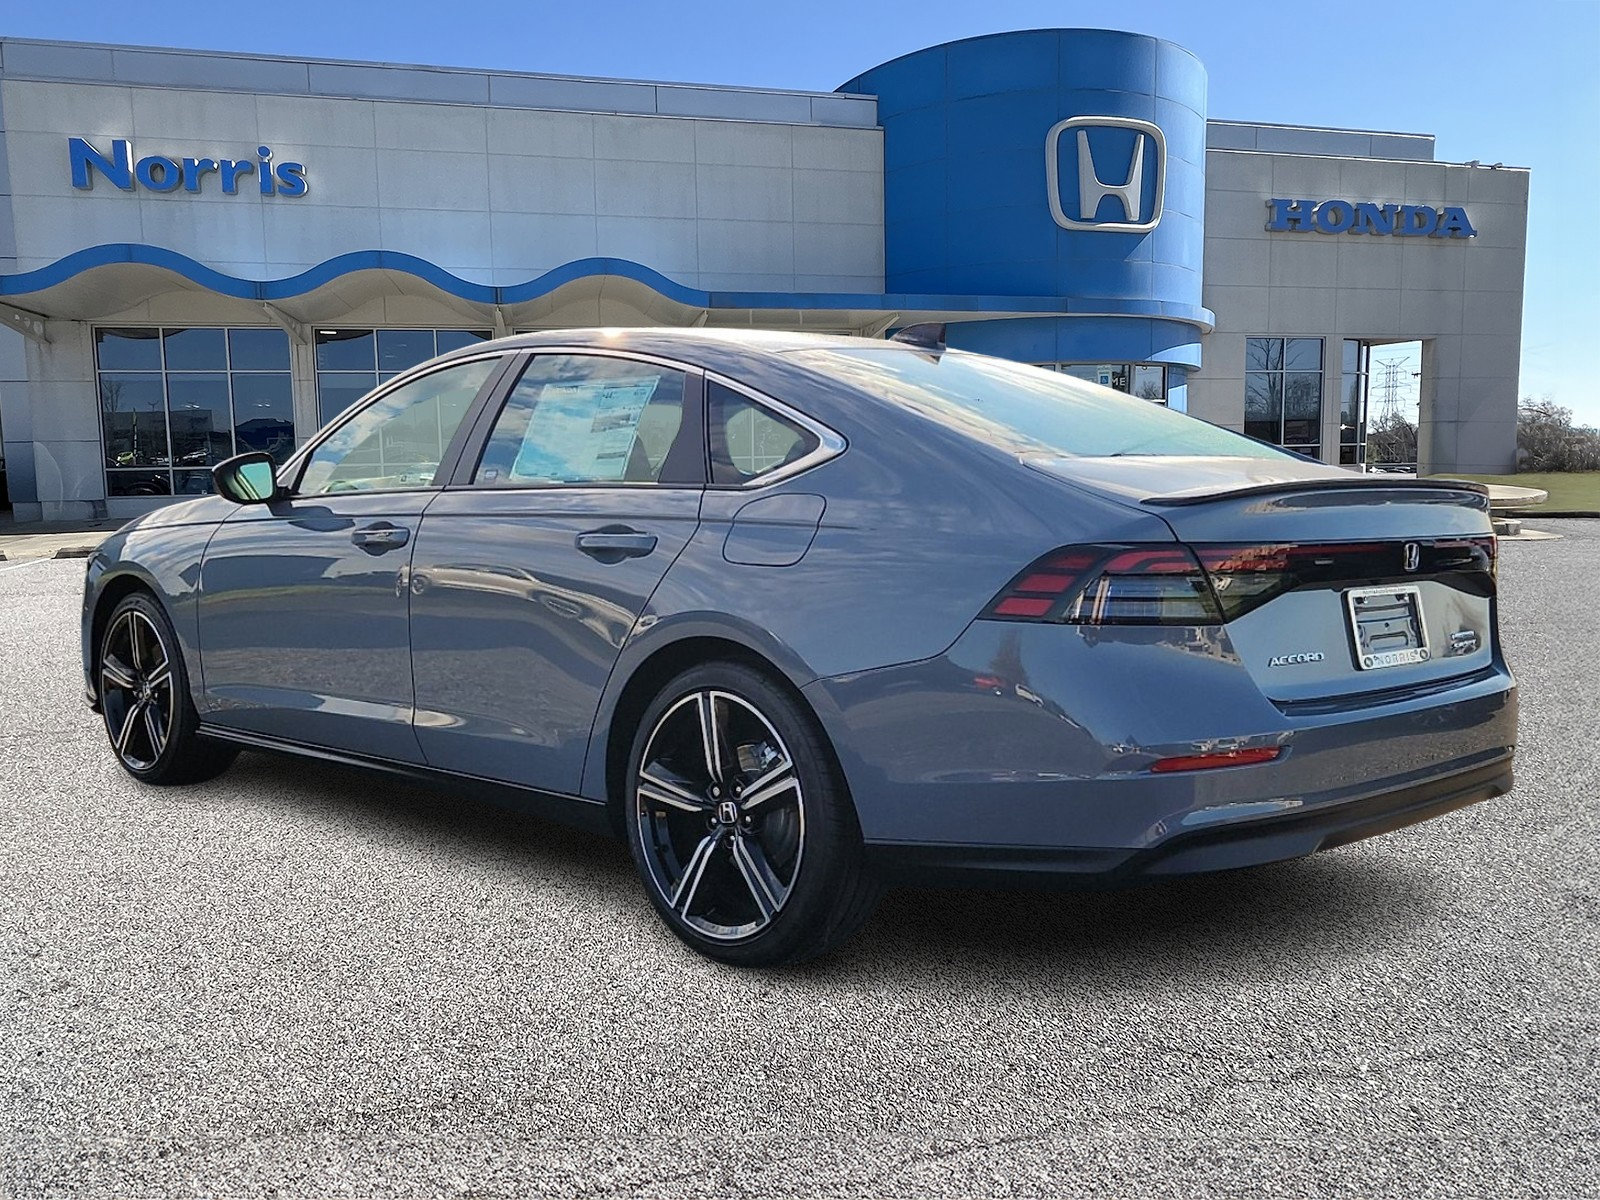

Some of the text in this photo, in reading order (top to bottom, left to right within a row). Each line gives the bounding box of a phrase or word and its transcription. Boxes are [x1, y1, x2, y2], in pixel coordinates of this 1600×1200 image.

[68, 137, 309, 198] Norris
[1266, 198, 1478, 239] HONDA
[1268, 652, 1325, 668] ACCORD
